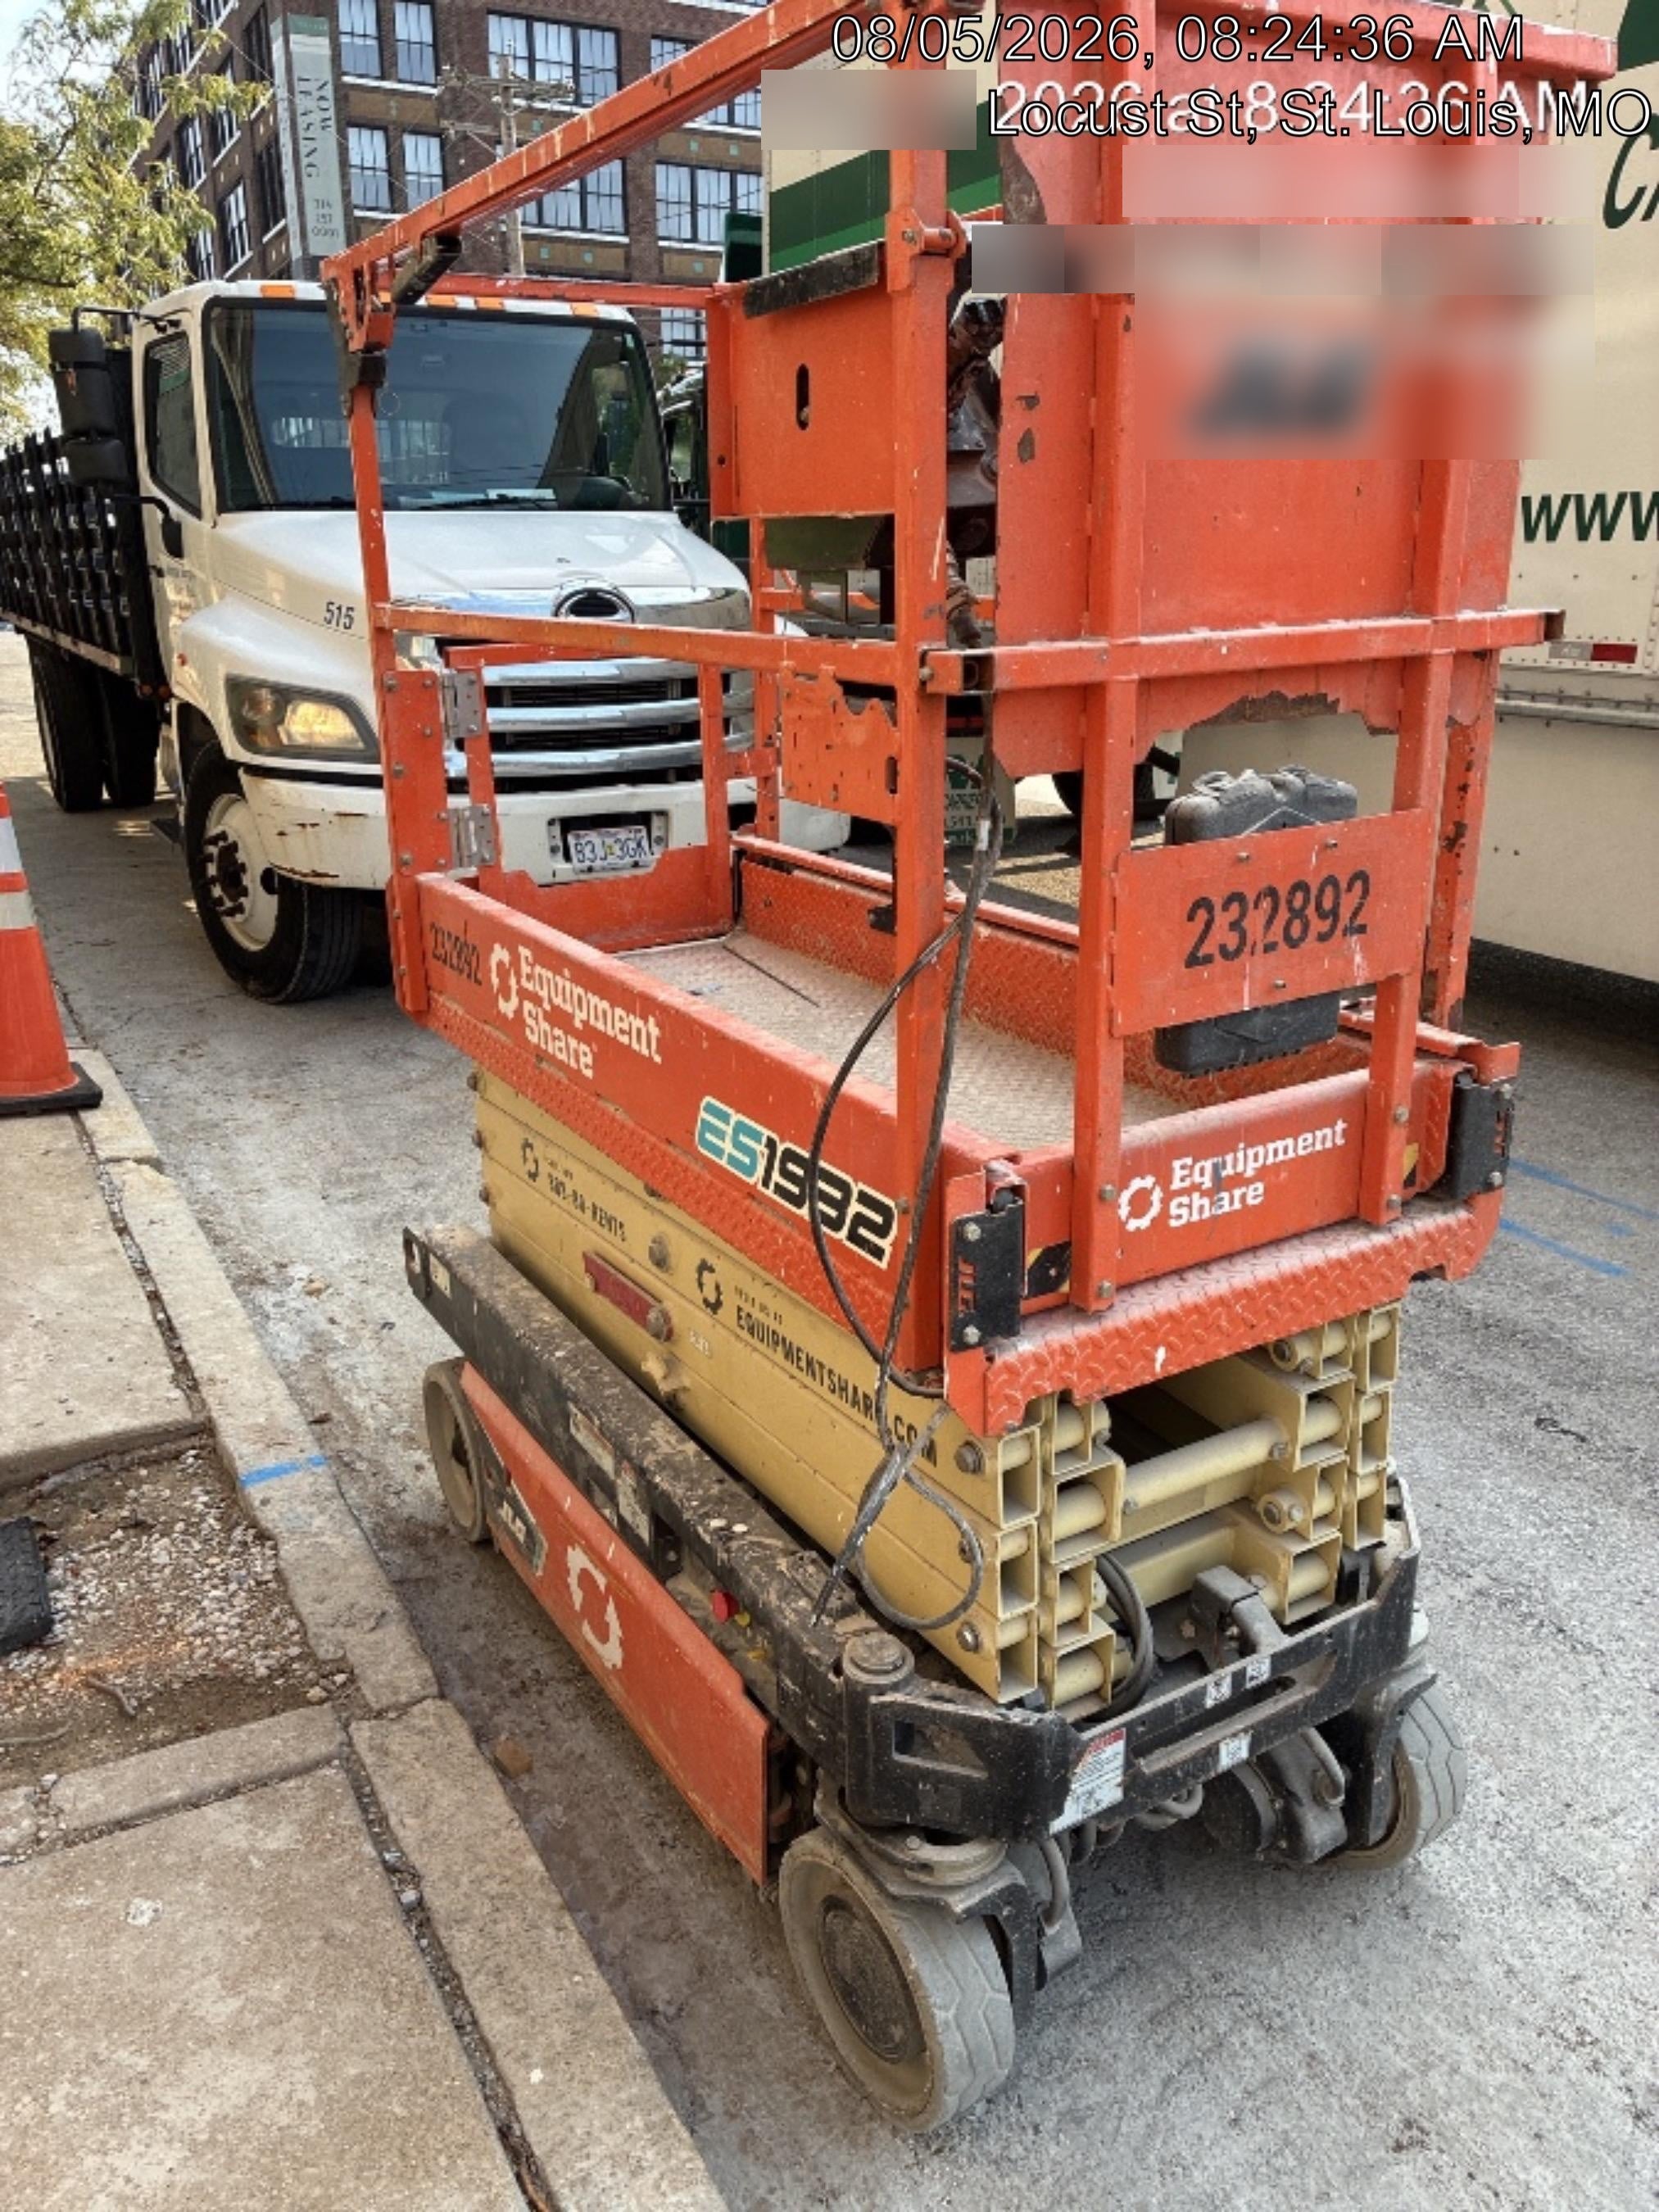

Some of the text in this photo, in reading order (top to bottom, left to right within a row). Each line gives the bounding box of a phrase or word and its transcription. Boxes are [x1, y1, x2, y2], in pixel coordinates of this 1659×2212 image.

[324, 601, 355, 630] 515
[1185, 869, 1371, 969] 232892
[518, 945, 662, 1065] Equipment
[522, 999, 595, 1080] Share
[1170, 1117, 1349, 1190] Equipment
[1168, 1180, 1265, 1229] Share
